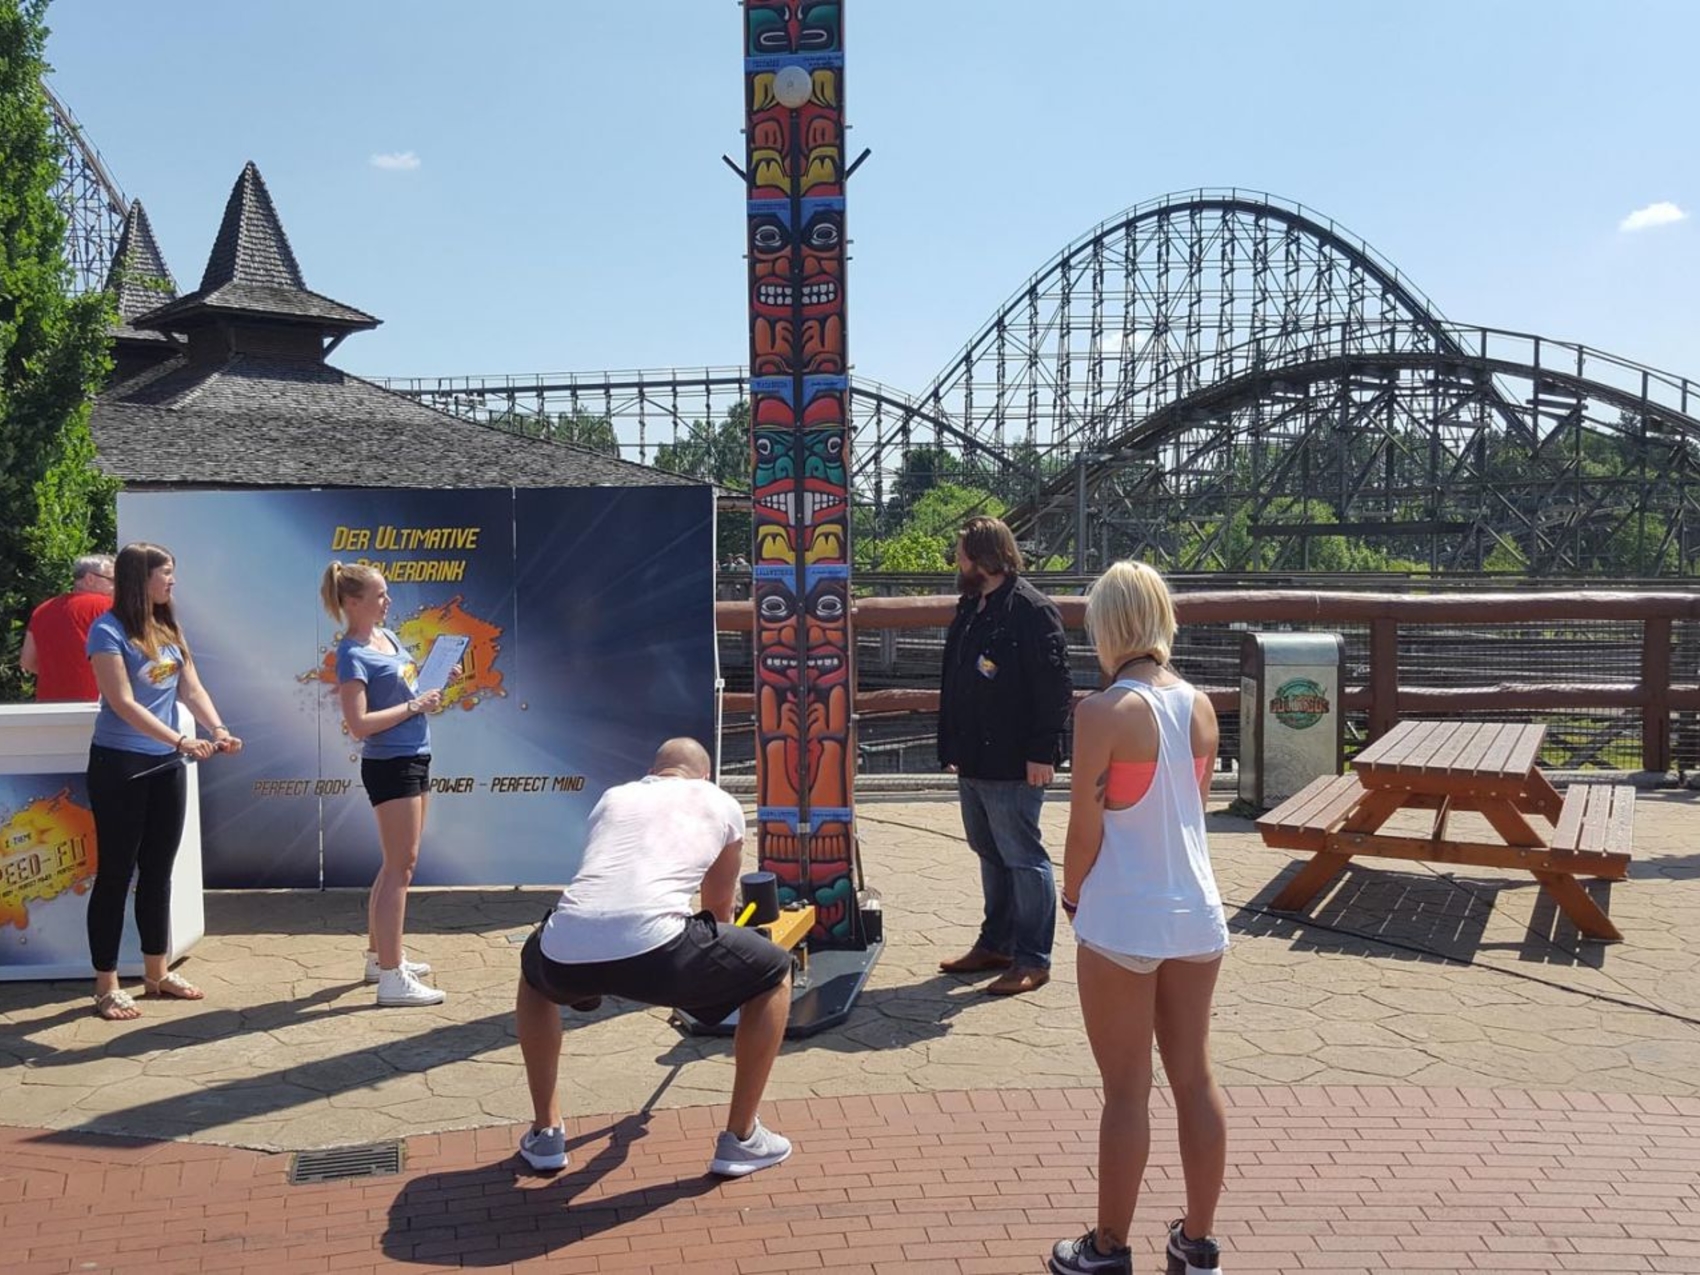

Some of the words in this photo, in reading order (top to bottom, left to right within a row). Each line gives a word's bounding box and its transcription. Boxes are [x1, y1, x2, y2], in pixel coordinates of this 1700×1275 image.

[332, 526, 371, 551] DER
[375, 526, 481, 550] ULTIMATIVE
[356, 558, 467, 582] WERDRINK
[252, 779, 312, 796] PERFECT
[314, 779, 352, 796] BODY
[429, 777, 474, 793] POWER
[490, 776, 550, 793] PERFECT
[552, 776, 585, 792] MIND
